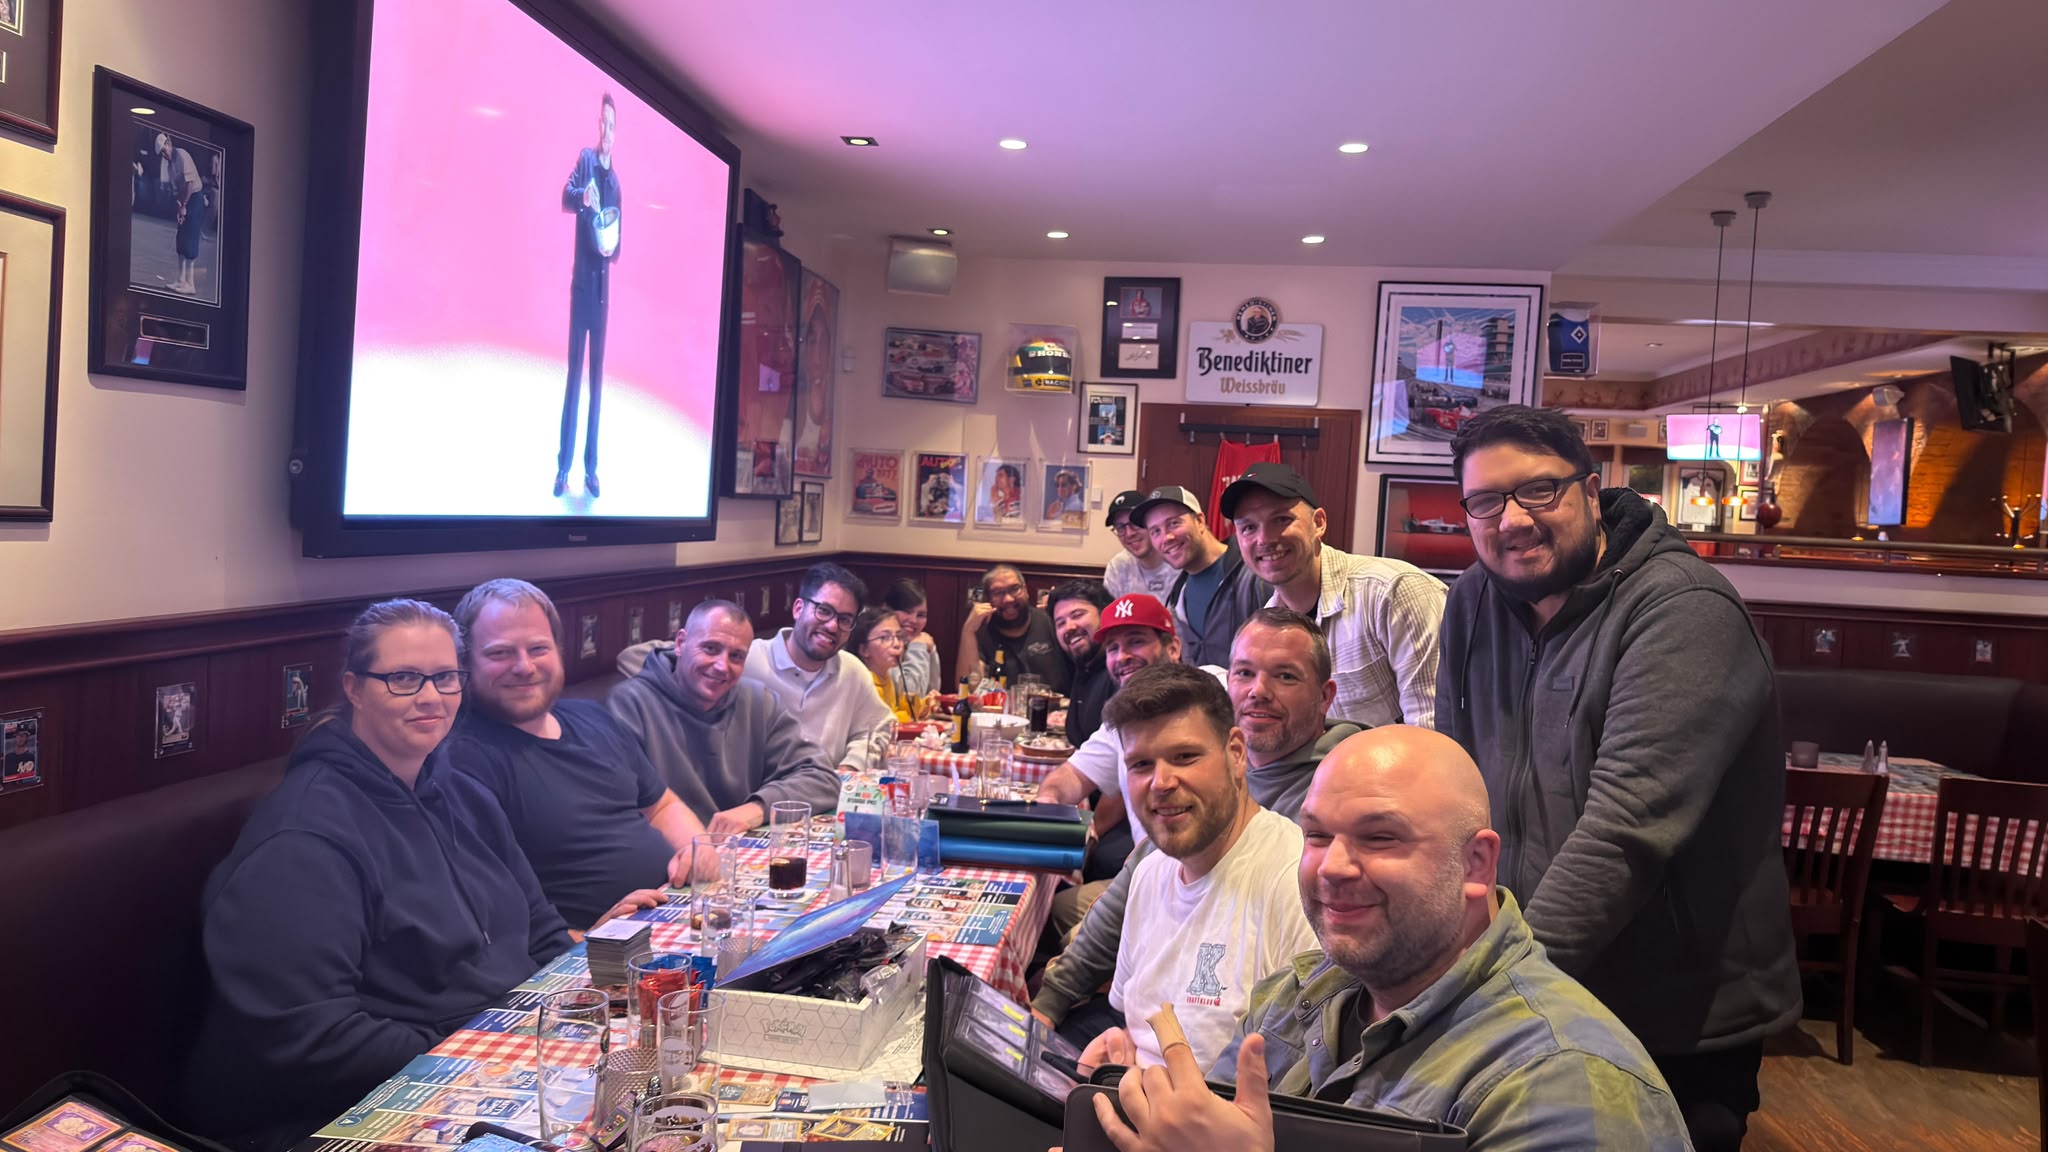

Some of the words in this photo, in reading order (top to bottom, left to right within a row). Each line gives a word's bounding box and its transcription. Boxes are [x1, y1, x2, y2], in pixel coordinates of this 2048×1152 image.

[1037, 349, 1071, 359] HOND
[1196, 346, 1313, 376] Benediktiner
[1220, 377, 1287, 395] Weissbräu
